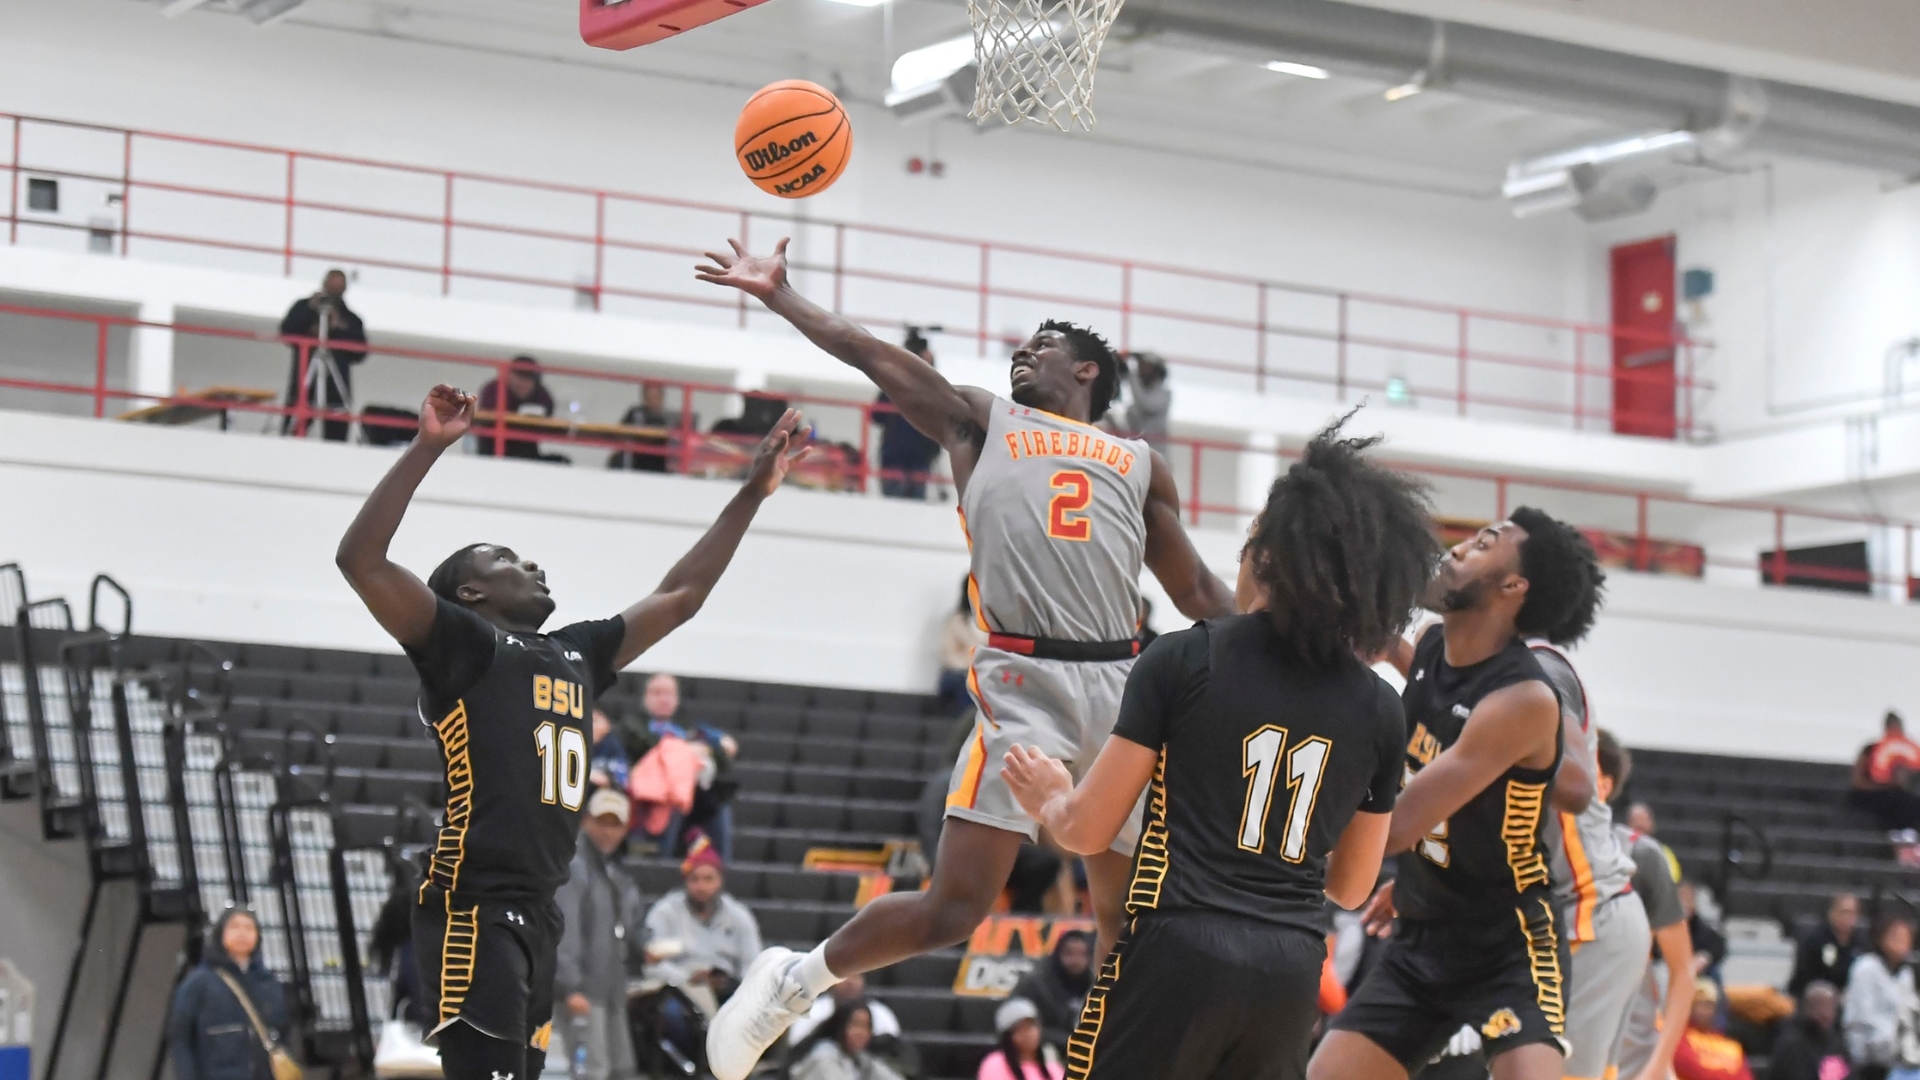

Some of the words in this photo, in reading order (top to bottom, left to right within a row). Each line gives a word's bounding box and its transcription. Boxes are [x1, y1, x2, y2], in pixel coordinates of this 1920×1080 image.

[744, 130, 819, 172] Wilson
[774, 163, 827, 195] NCAA
[1004, 430, 1135, 477] FIREBIRDS
[1047, 469, 1092, 542] 2
[533, 674, 584, 720] BSU
[533, 720, 587, 812] 10
[1407, 721, 1442, 766] BS
[1238, 723, 1333, 864] 11
